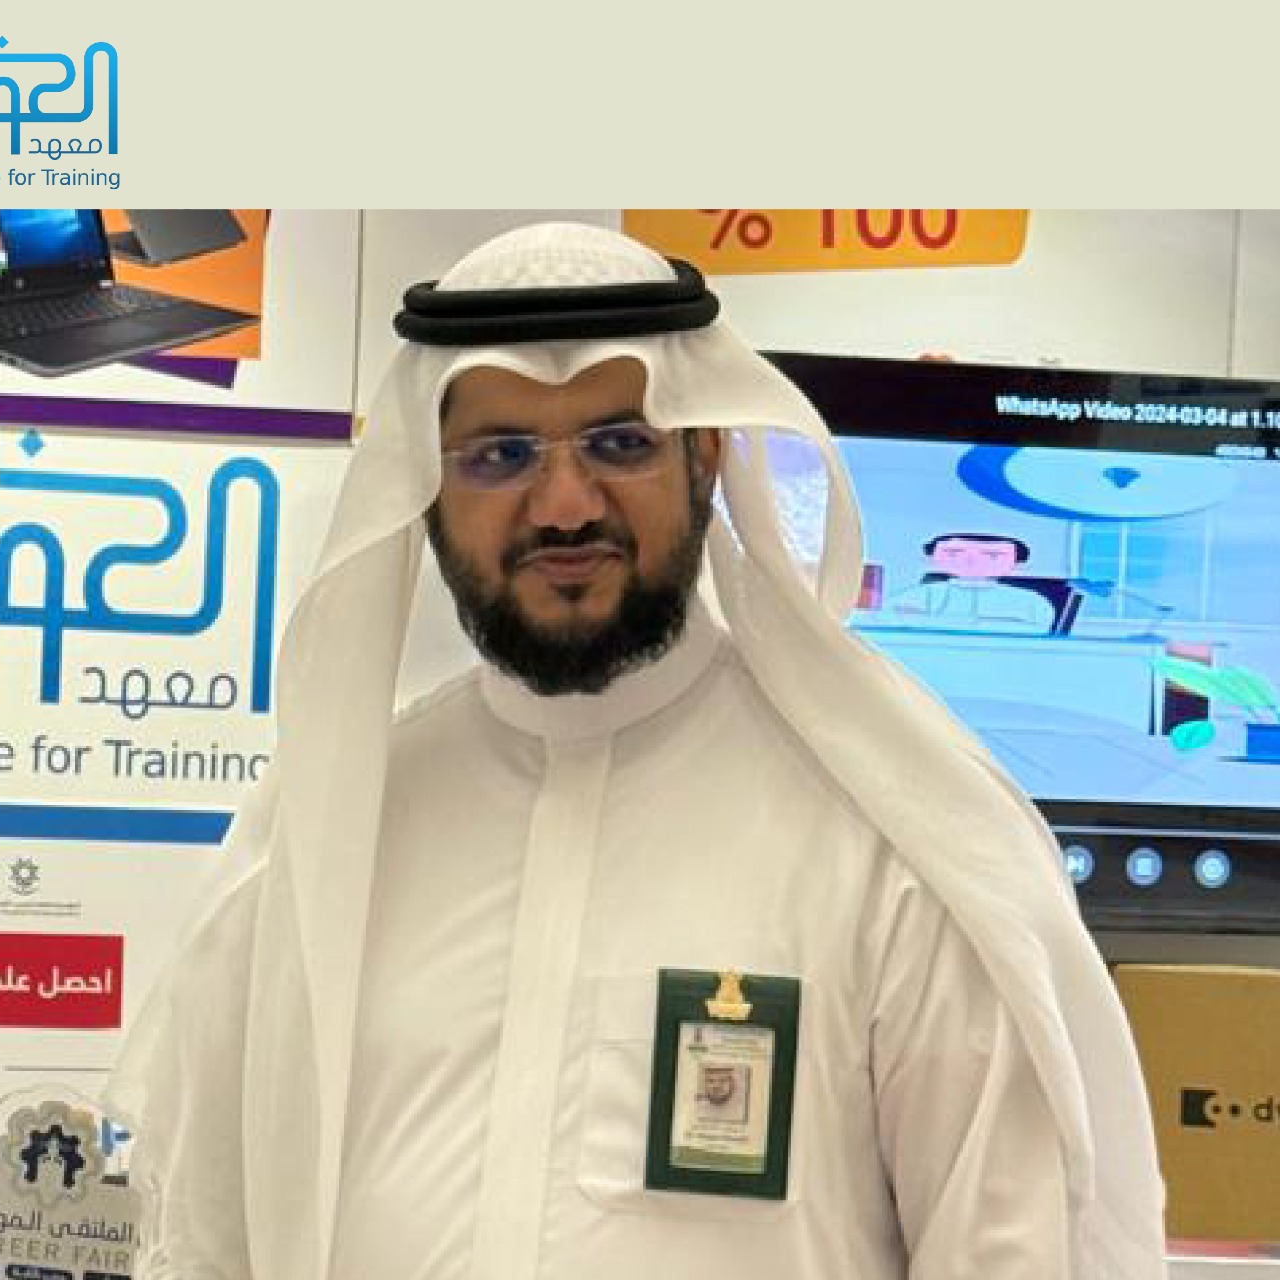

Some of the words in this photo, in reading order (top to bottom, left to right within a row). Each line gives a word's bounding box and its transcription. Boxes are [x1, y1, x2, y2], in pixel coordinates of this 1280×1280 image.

[996, 395, 1082, 421] WhatsApp
[1084, 400, 1131, 421] Video
[78, 666, 238, 720] معهد
[31, 734, 93, 775] for
[37, 965, 113, 999] احصل
[73, 1245, 131, 1273] FAIR
